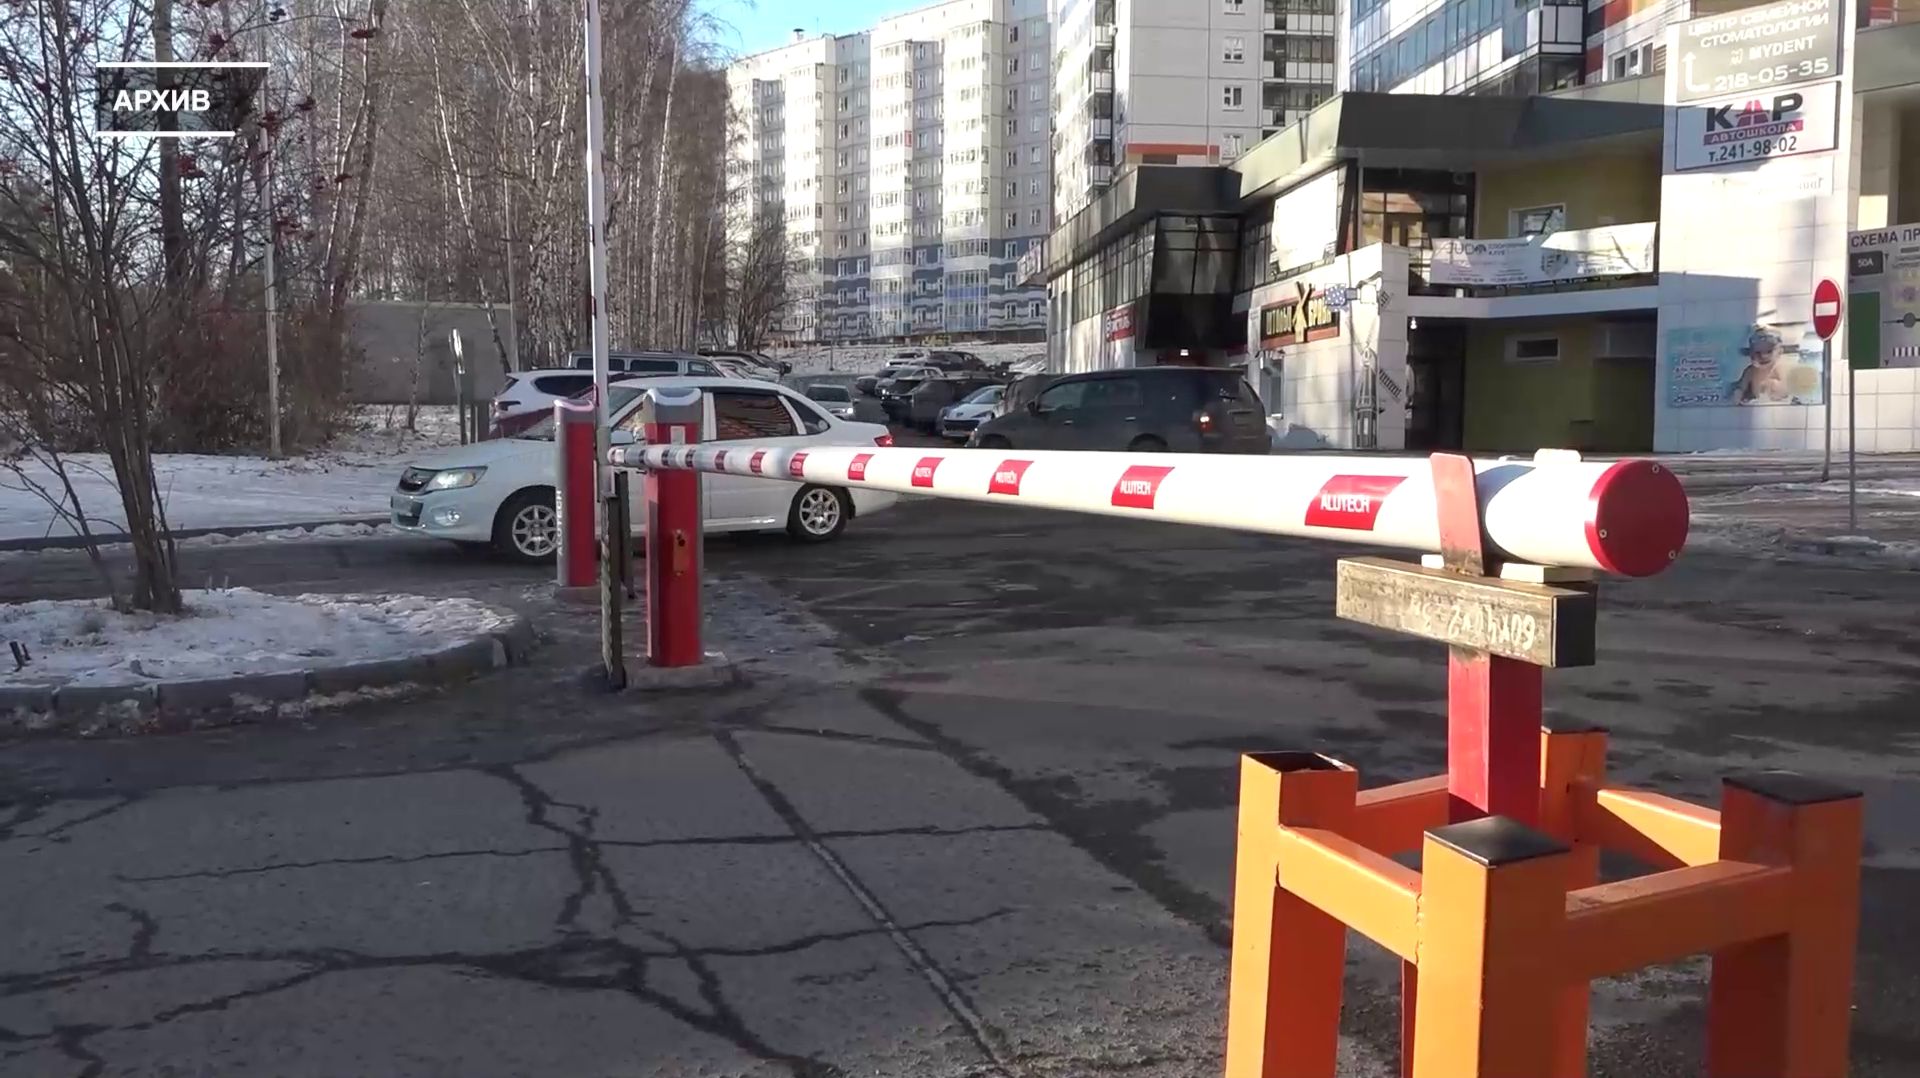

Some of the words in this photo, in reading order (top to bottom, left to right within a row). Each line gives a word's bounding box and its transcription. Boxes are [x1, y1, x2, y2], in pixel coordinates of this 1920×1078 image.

[1688, 16, 1738, 36] ЦЕНТР
[1741, 0, 1830, 26] СЕМЕЙНОЙ
[1700, 13, 1830, 48] СТОМАТОЛОГИИ
[1748, 35, 1816, 60] MYDENT
[1714, 57, 1829, 92] 218-05-35
[1711, 121, 1796, 144] АВТОШКОЛА
[1850, 231, 1898, 248] СХЕМА
[1120, 480, 1151, 495] ALUTECH
[1320, 493, 1370, 513] ALUTECH
